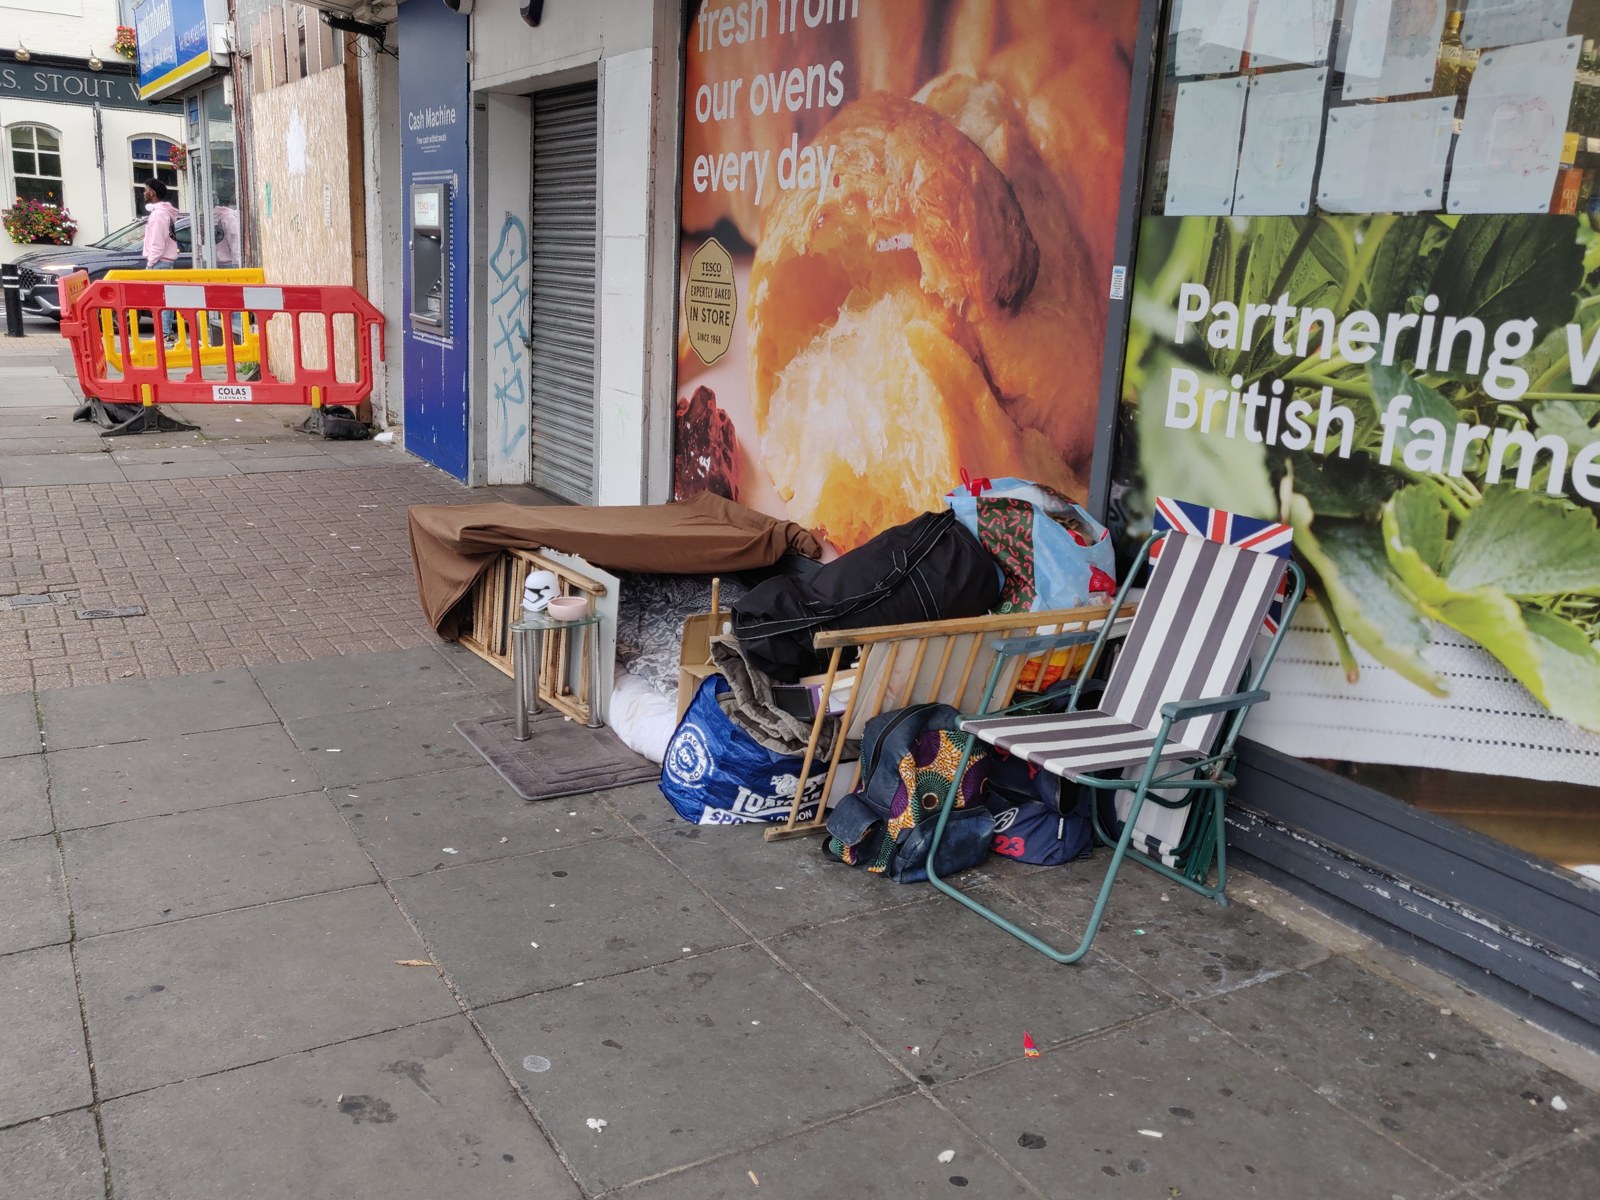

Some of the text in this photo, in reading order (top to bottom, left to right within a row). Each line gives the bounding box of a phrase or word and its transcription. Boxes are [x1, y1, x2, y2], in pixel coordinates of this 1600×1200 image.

[697, 0, 768, 53] fresh
[695, 60, 844, 123] our ovens
[408, 104, 456, 131] Cash Machine
[693, 150, 770, 206] every
[701, 262, 722, 273] TESCO
[690, 285, 732, 300] EXPERTLY BAKED
[689, 305, 731, 327] IN STORE
[696, 332, 710, 343] SINCE
[1174, 282, 1539, 400] Partnering
[218, 387, 247, 396] COLAS
[1164, 367, 1356, 460] British
[995, 835, 1025, 858] 23
